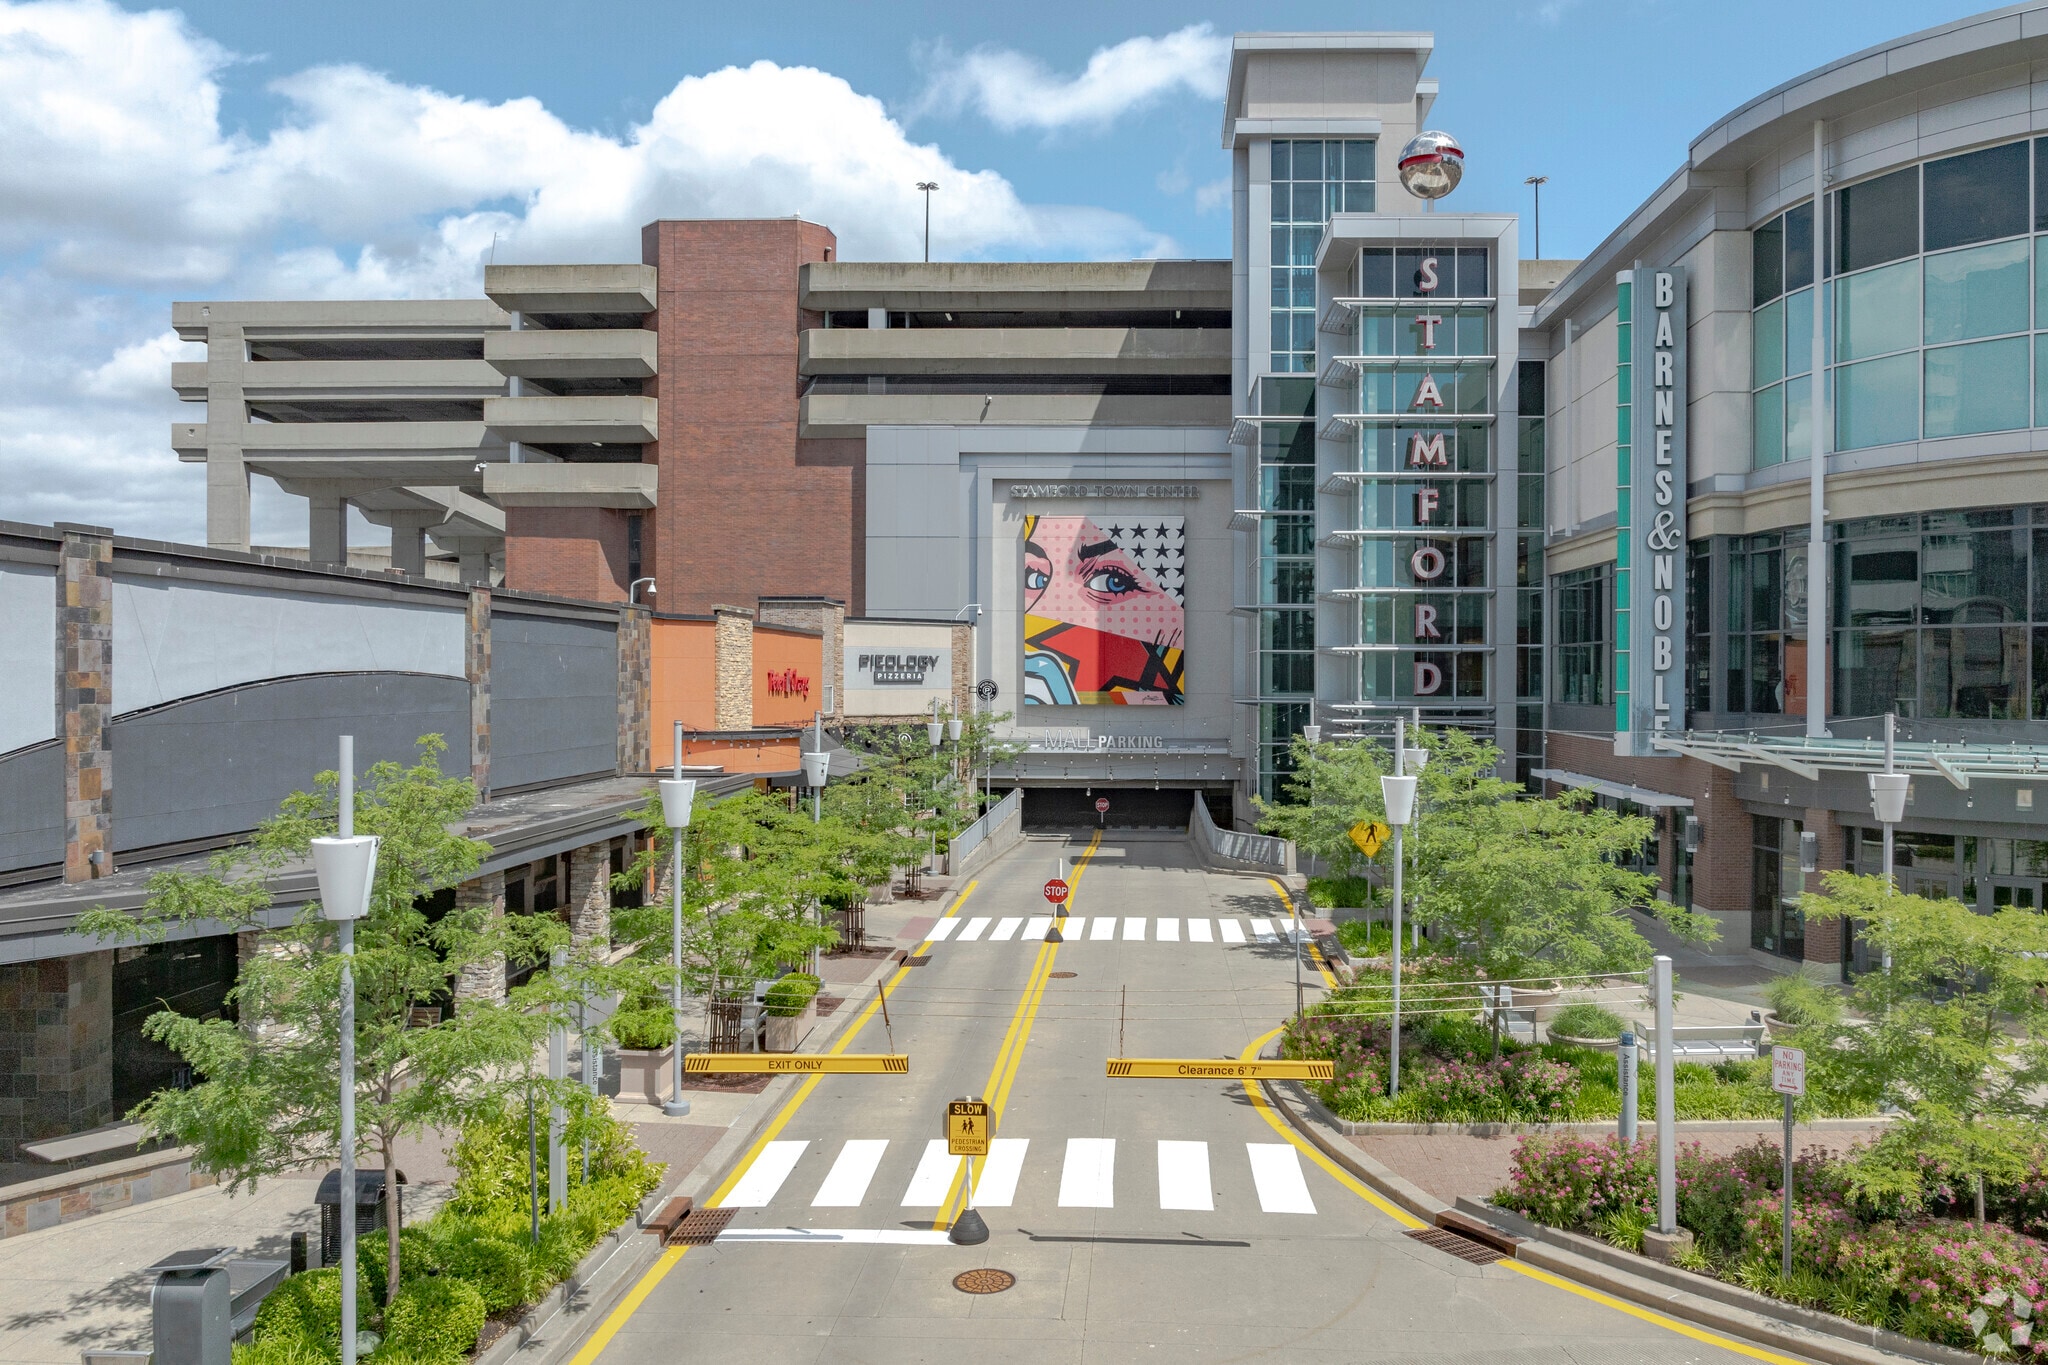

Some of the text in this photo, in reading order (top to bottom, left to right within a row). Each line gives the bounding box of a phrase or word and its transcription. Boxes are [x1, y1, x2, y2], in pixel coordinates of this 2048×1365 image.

[1410, 257, 1447, 695] STAMFORD
[1010, 484, 1200, 498] STAMFORD TOWN CENTER
[858, 654, 940, 671] PIEOLOGY
[877, 672, 922, 680] PIZZERIA
[1045, 729, 1163, 749] MALL PARKING
[1096, 801, 1109, 809] STOP
[1045, 886, 1068, 897] STOP
[1782, 1050, 1794, 1061] NO
[768, 1060, 823, 1070] EXIT ONLY
[1178, 1065, 1234, 1076] Clearance
[1238, 1066, 1248, 1076] 6'
[1774, 1060, 1802, 1072] PARKING
[1622, 1053, 1631, 1097] Assistance
[1781, 1076, 1796, 1085] TIME
[954, 1104, 983, 1115] SLOW
